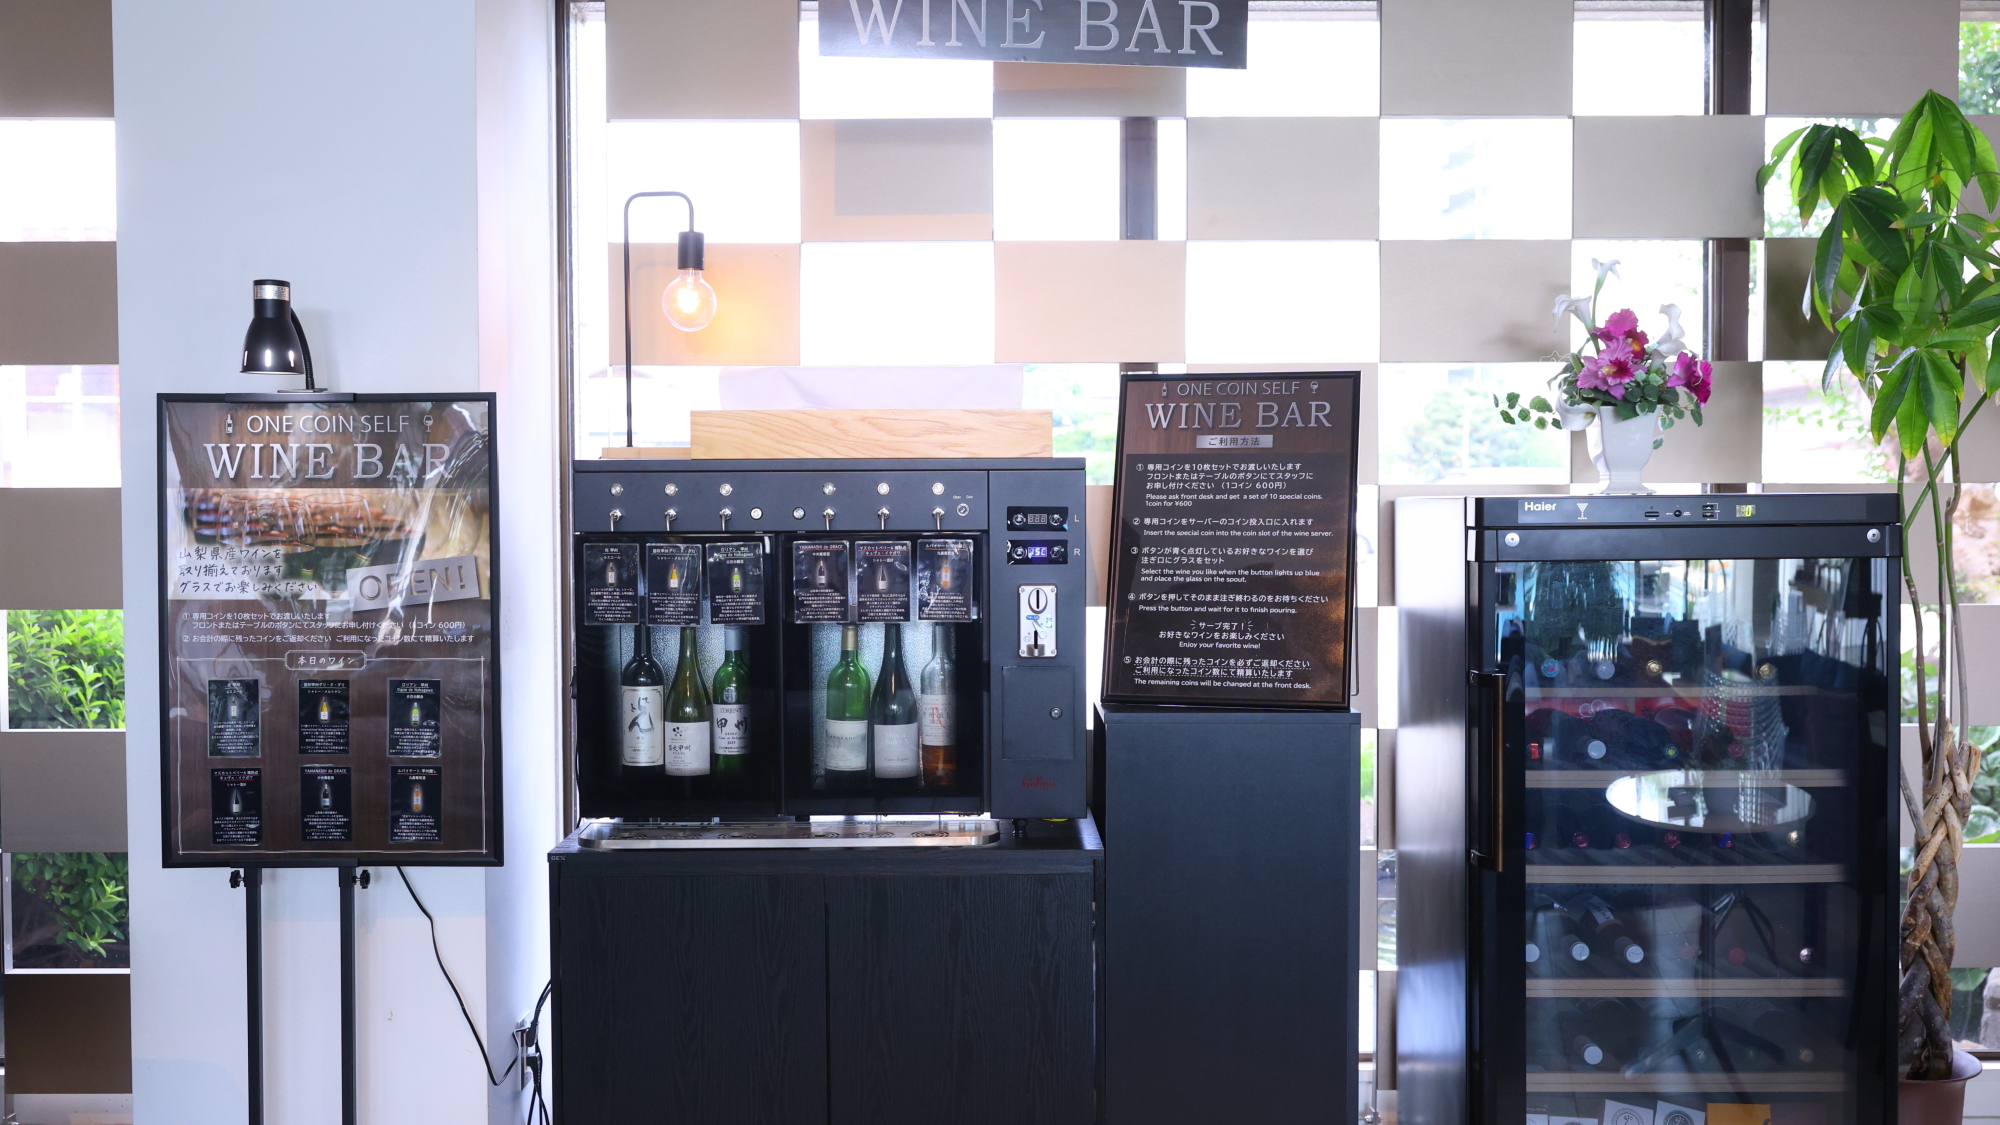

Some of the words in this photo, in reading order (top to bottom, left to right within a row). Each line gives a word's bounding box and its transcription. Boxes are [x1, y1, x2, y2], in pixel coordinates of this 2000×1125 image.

[850, 0, 1046, 48] WINE
[1074, 0, 1223, 56] BAR
[1177, 382, 1211, 396] ONE
[1216, 382, 1257, 395] COIN
[1262, 382, 1300, 395] SELF
[1145, 402, 1242, 429] WINE
[1256, 402, 1332, 428] BAR
[246, 415, 293, 434] ONE
[300, 414, 354, 434] COIN
[361, 414, 409, 434] SELF
[1208, 437, 1261, 446] ご利用方法
[203, 443, 336, 480] WINE
[353, 443, 453, 480] BAR
[1524, 502, 1557, 511] Haier
[179, 546, 282, 561] 山梨県産ワインを
[1142, 547, 1314, 555] ボタンが青く点灯しているお好きなワインを選び
[178, 564, 283, 578] 取り揃えております
[180, 580, 318, 594] グラスでお楽しみください
[1139, 593, 1329, 603] ボタンを押してそのまま注ぎ終わるのをお待ちください
[1159, 631, 1285, 640] お好きなワインをお楽しみください
[298, 655, 354, 665] 本日のワイン
[1135, 656, 1310, 668] お会計の際に残ったコインを必ずご返却ください
[1135, 666, 1293, 677] ご利用になったコイン数にて精算いたします
